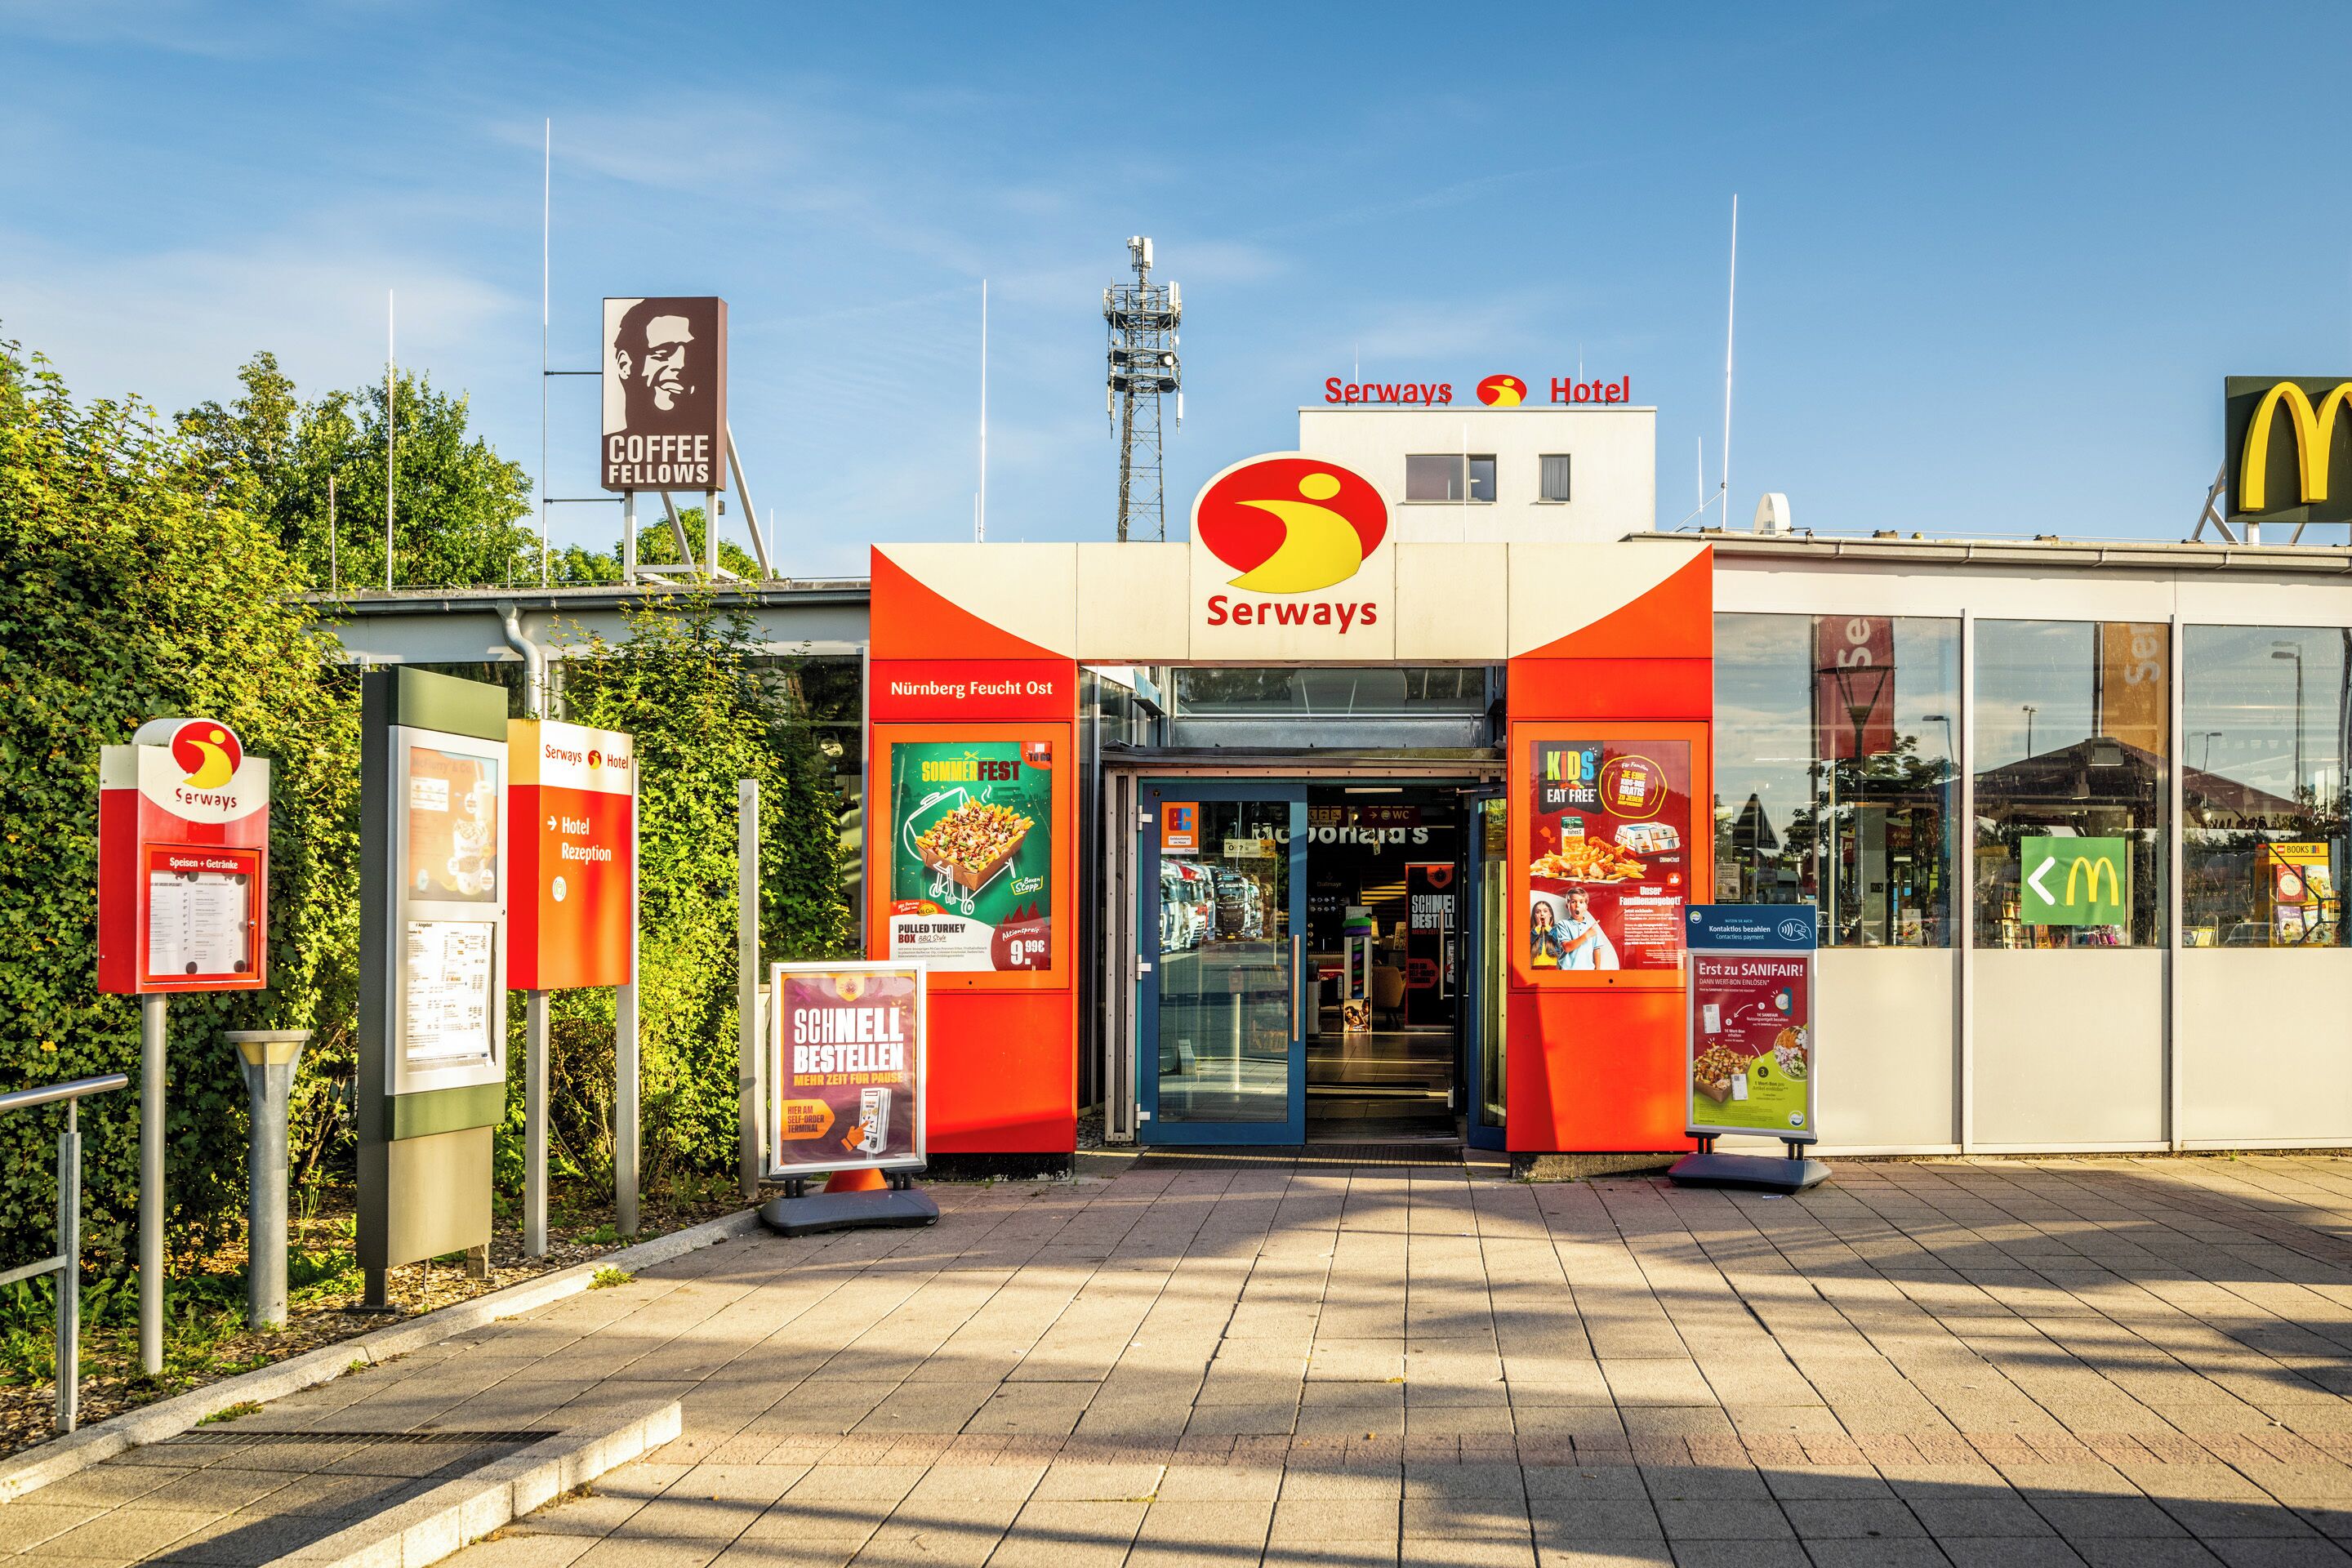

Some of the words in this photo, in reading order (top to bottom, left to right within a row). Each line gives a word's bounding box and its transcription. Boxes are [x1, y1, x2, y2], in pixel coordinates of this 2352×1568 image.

[1325, 376, 1453, 407] Serways
[1551, 376, 1629, 403] Hotel
[608, 434, 709, 463] COFFEE
[608, 464, 709, 483] FELLOWS
[1206, 595, 1378, 634] Serways
[891, 680, 965, 698] Nürnberg
[970, 680, 1022, 695] Feucht
[1027, 680, 1053, 695] Ost
[545, 743, 582, 765] Serways
[607, 753, 629, 770] Hotel
[921, 760, 1021, 782] SOMMERFEST
[1547, 789, 1567, 803] EAT
[1619, 785, 1645, 797] GRATIS
[175, 788, 238, 812] Serways
[1393, 810, 1410, 820] WC
[562, 817, 590, 836] Hotel
[561, 842, 612, 866] Rezeption
[2287, 845, 2310, 853] BOOKS
[170, 858, 198, 869] Speisen
[206, 858, 238, 870] Getränke
[1015, 882, 1039, 893] Stopp
[1640, 886, 1662, 896] Unser
[898, 924, 930, 933] PULLED
[932, 924, 966, 933] TURKEY
[1412, 914, 1454, 929] BESTLL
[898, 934, 915, 943] BOX
[933, 933, 947, 942] Style
[1699, 963, 1722, 975] Erst
[1724, 966, 1738, 975] zu
[1741, 963, 1803, 977] SANIFAIR!
[795, 1008, 903, 1044] SCHNELL
[794, 1043, 902, 1073] BESTELLEN
[794, 1075, 824, 1085] MEHR
[826, 1074, 848, 1085] ZEIT
[850, 1072, 869, 1084] FÜR
[871, 1074, 902, 1084] PAUSE
[787, 1106, 802, 1115] HIER
[803, 1105, 813, 1114] AM
[787, 1114, 825, 1124] SELF-ORDER
[787, 1124, 819, 1134] TERMINAL
